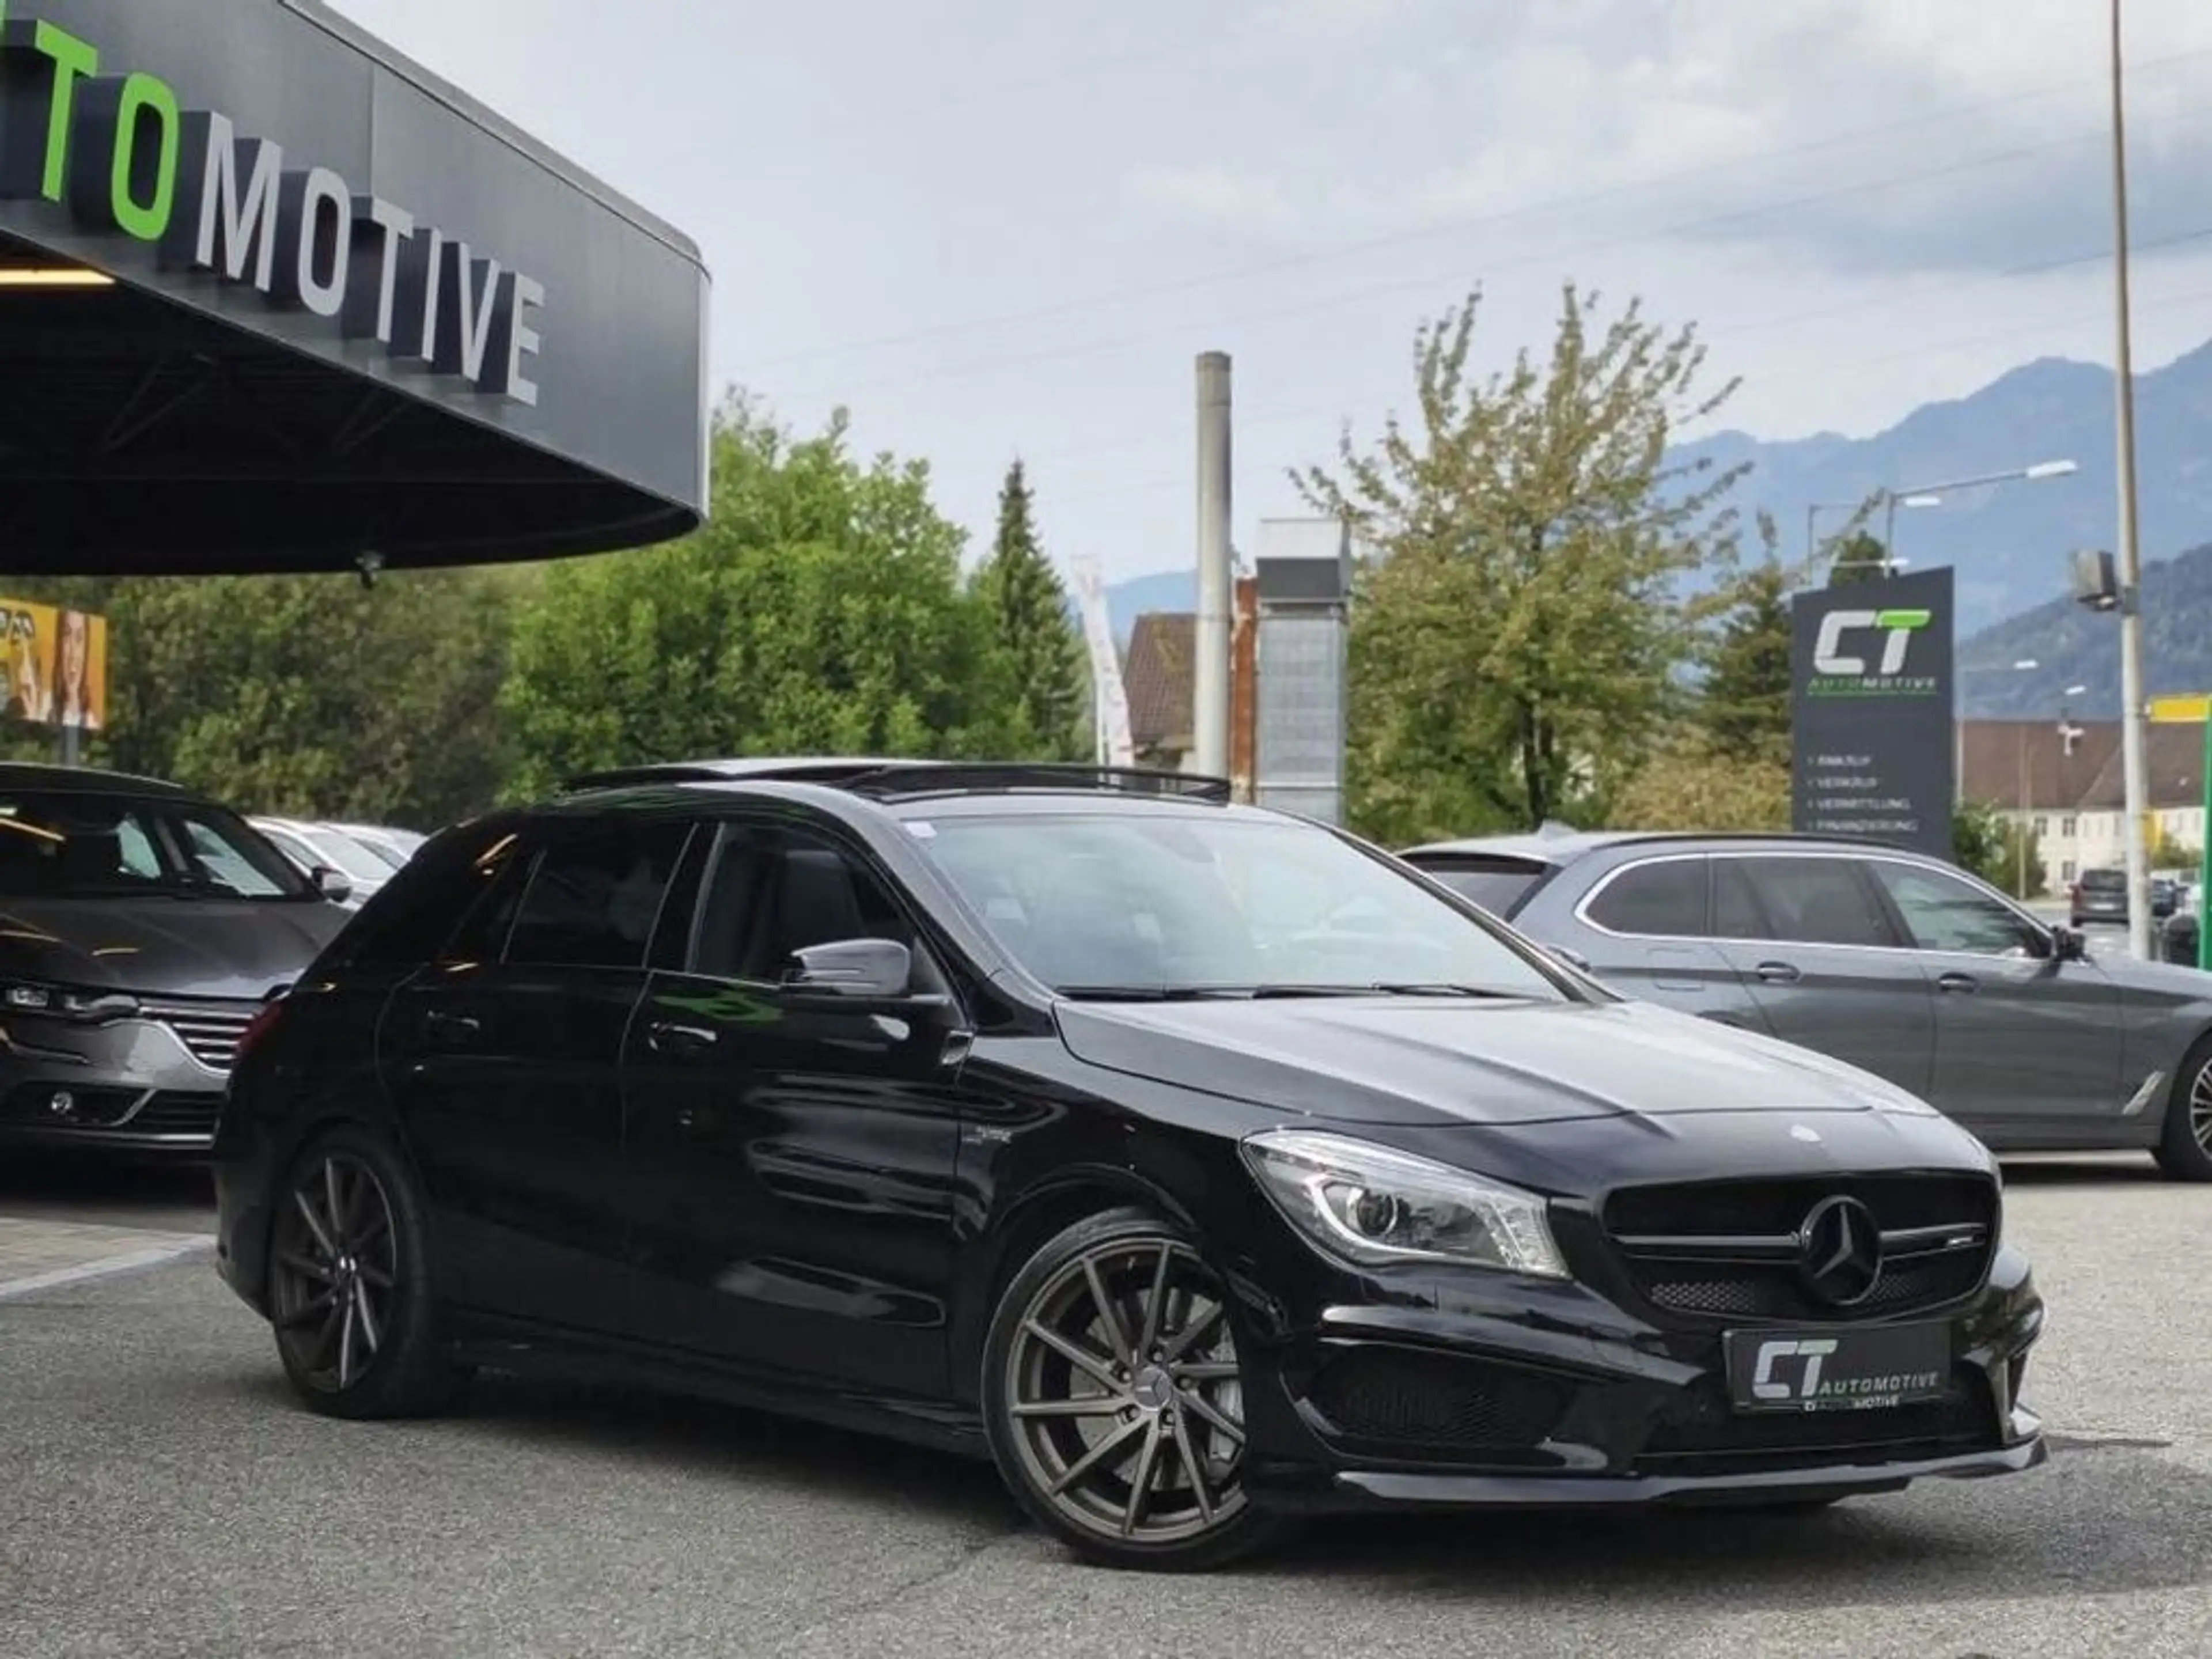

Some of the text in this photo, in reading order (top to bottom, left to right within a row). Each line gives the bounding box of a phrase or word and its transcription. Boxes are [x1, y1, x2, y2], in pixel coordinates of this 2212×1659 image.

[0, 0, 545, 407] TOMOTIVE
[1815, 609, 1931, 674] CT
[1752, 1339, 1938, 1399] CT AUTOMOTIVE
